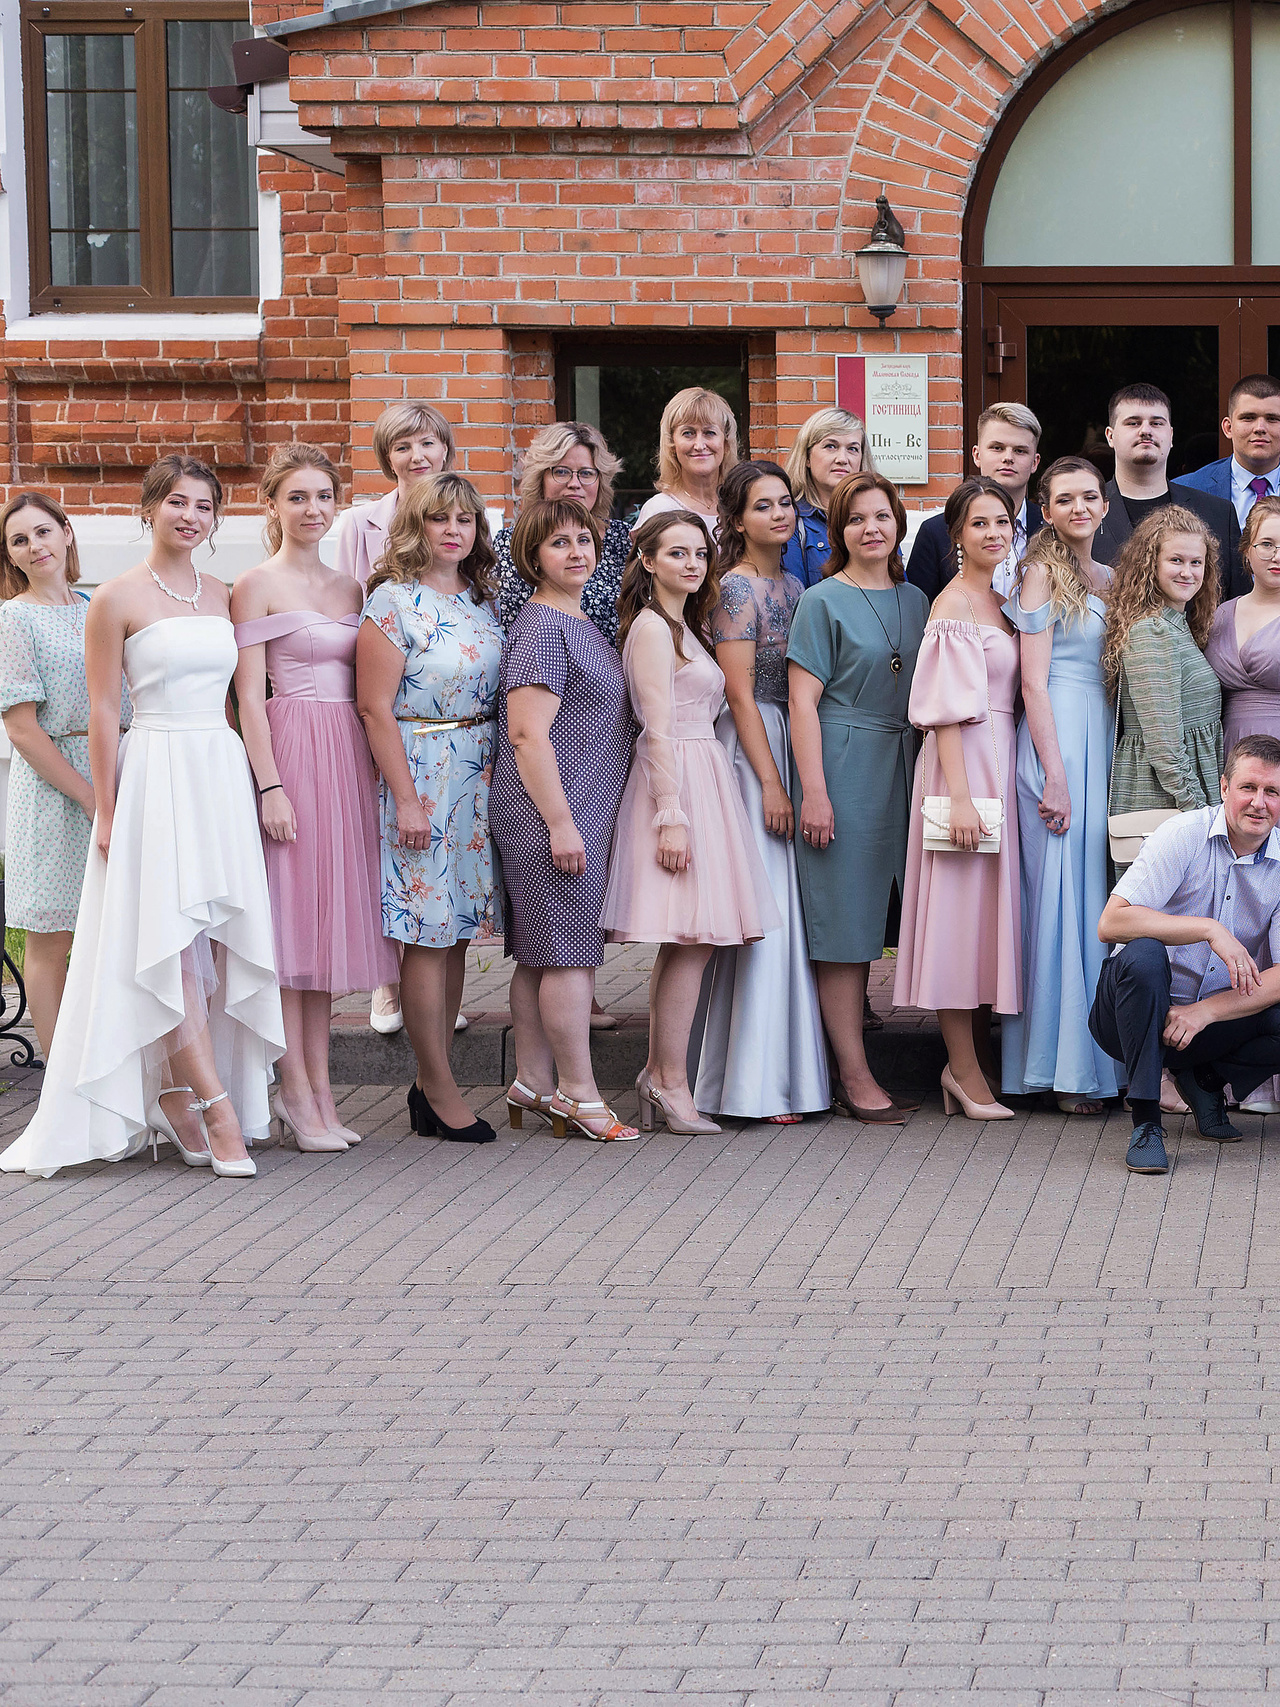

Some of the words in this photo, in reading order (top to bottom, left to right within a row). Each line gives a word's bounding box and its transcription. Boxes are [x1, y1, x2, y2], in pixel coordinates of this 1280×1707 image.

[872, 404, 921, 418] ГОСТИНИЦА
[871, 433, 891, 448] Пн
[905, 433, 922, 448] Вс
[872, 453, 923, 463] руглосуточно
